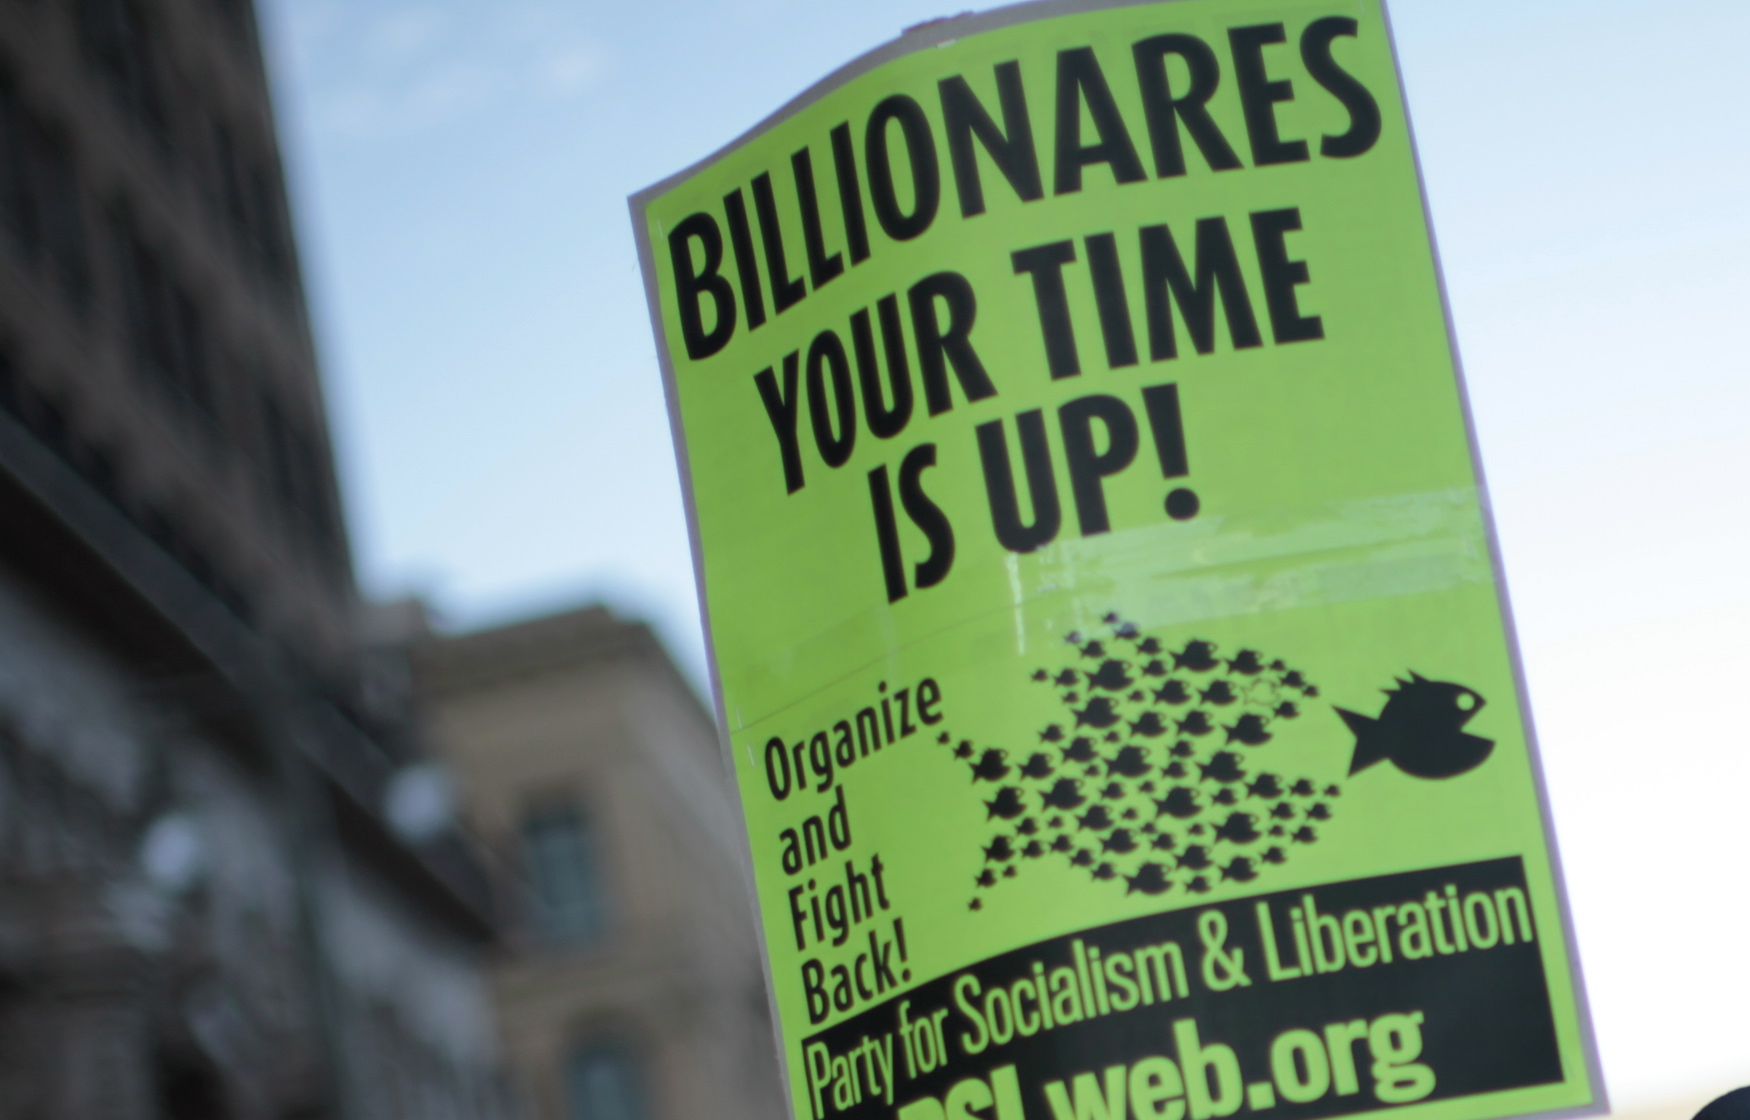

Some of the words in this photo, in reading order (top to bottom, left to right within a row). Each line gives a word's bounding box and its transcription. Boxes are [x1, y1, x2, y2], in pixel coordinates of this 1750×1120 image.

[667, 15, 1382, 362] BILLIONARES
[753, 271, 998, 496] YOUR
[1010, 207, 1325, 381] TIME
[867, 442, 956, 605] IS
[975, 383, 1200, 555] UP!
[764, 676, 944, 801] Organize
[779, 784, 852, 876] and
[788, 852, 891, 951] Fight
[801, 916, 912, 1025] Back!
[806, 1033, 895, 1120] Party
[898, 1000, 950, 1080] for
[952, 937, 1191, 1055] Socialism
[1196, 909, 1253, 992] &
[1254, 882, 1535, 982] Liberation
